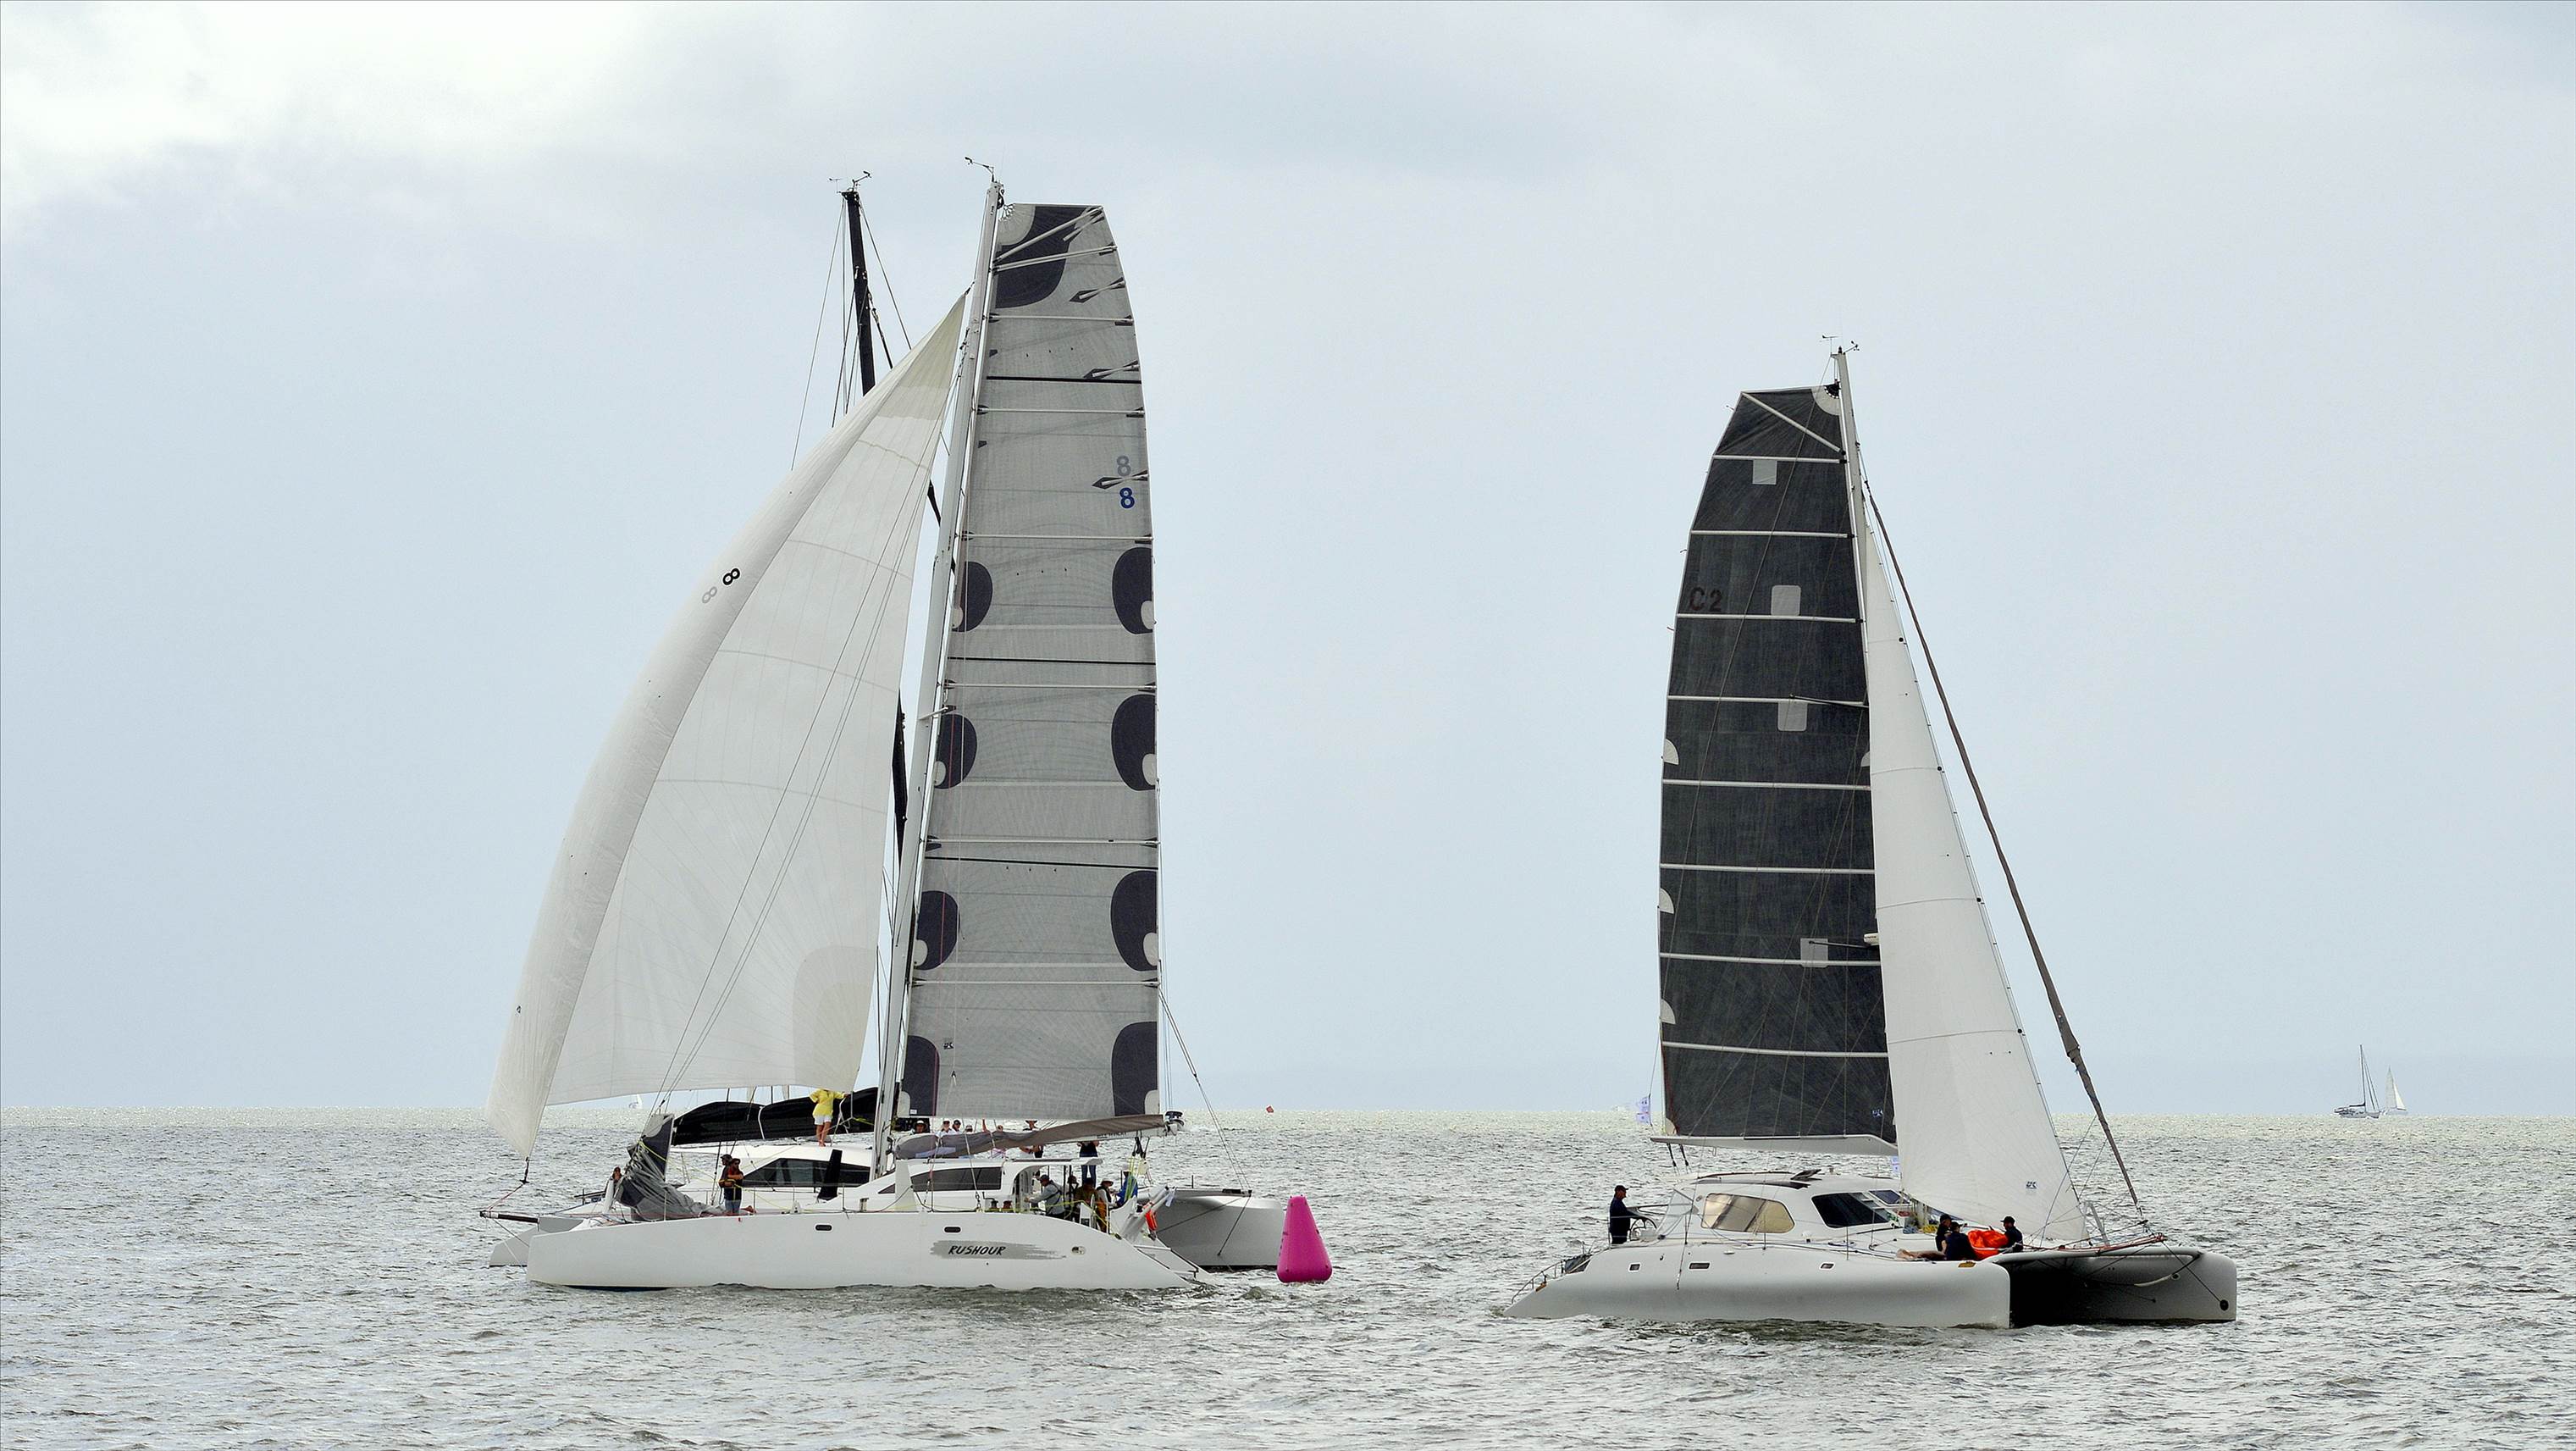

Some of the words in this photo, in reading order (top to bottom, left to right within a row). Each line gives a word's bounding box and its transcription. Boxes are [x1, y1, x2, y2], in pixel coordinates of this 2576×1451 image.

[1117, 456, 1131, 476] 8
[1119, 487, 1135, 509] 8
[722, 568, 741, 586] 8
[1689, 587, 1722, 612] C2
[948, 1245, 1006, 1255] RUSHOUR
